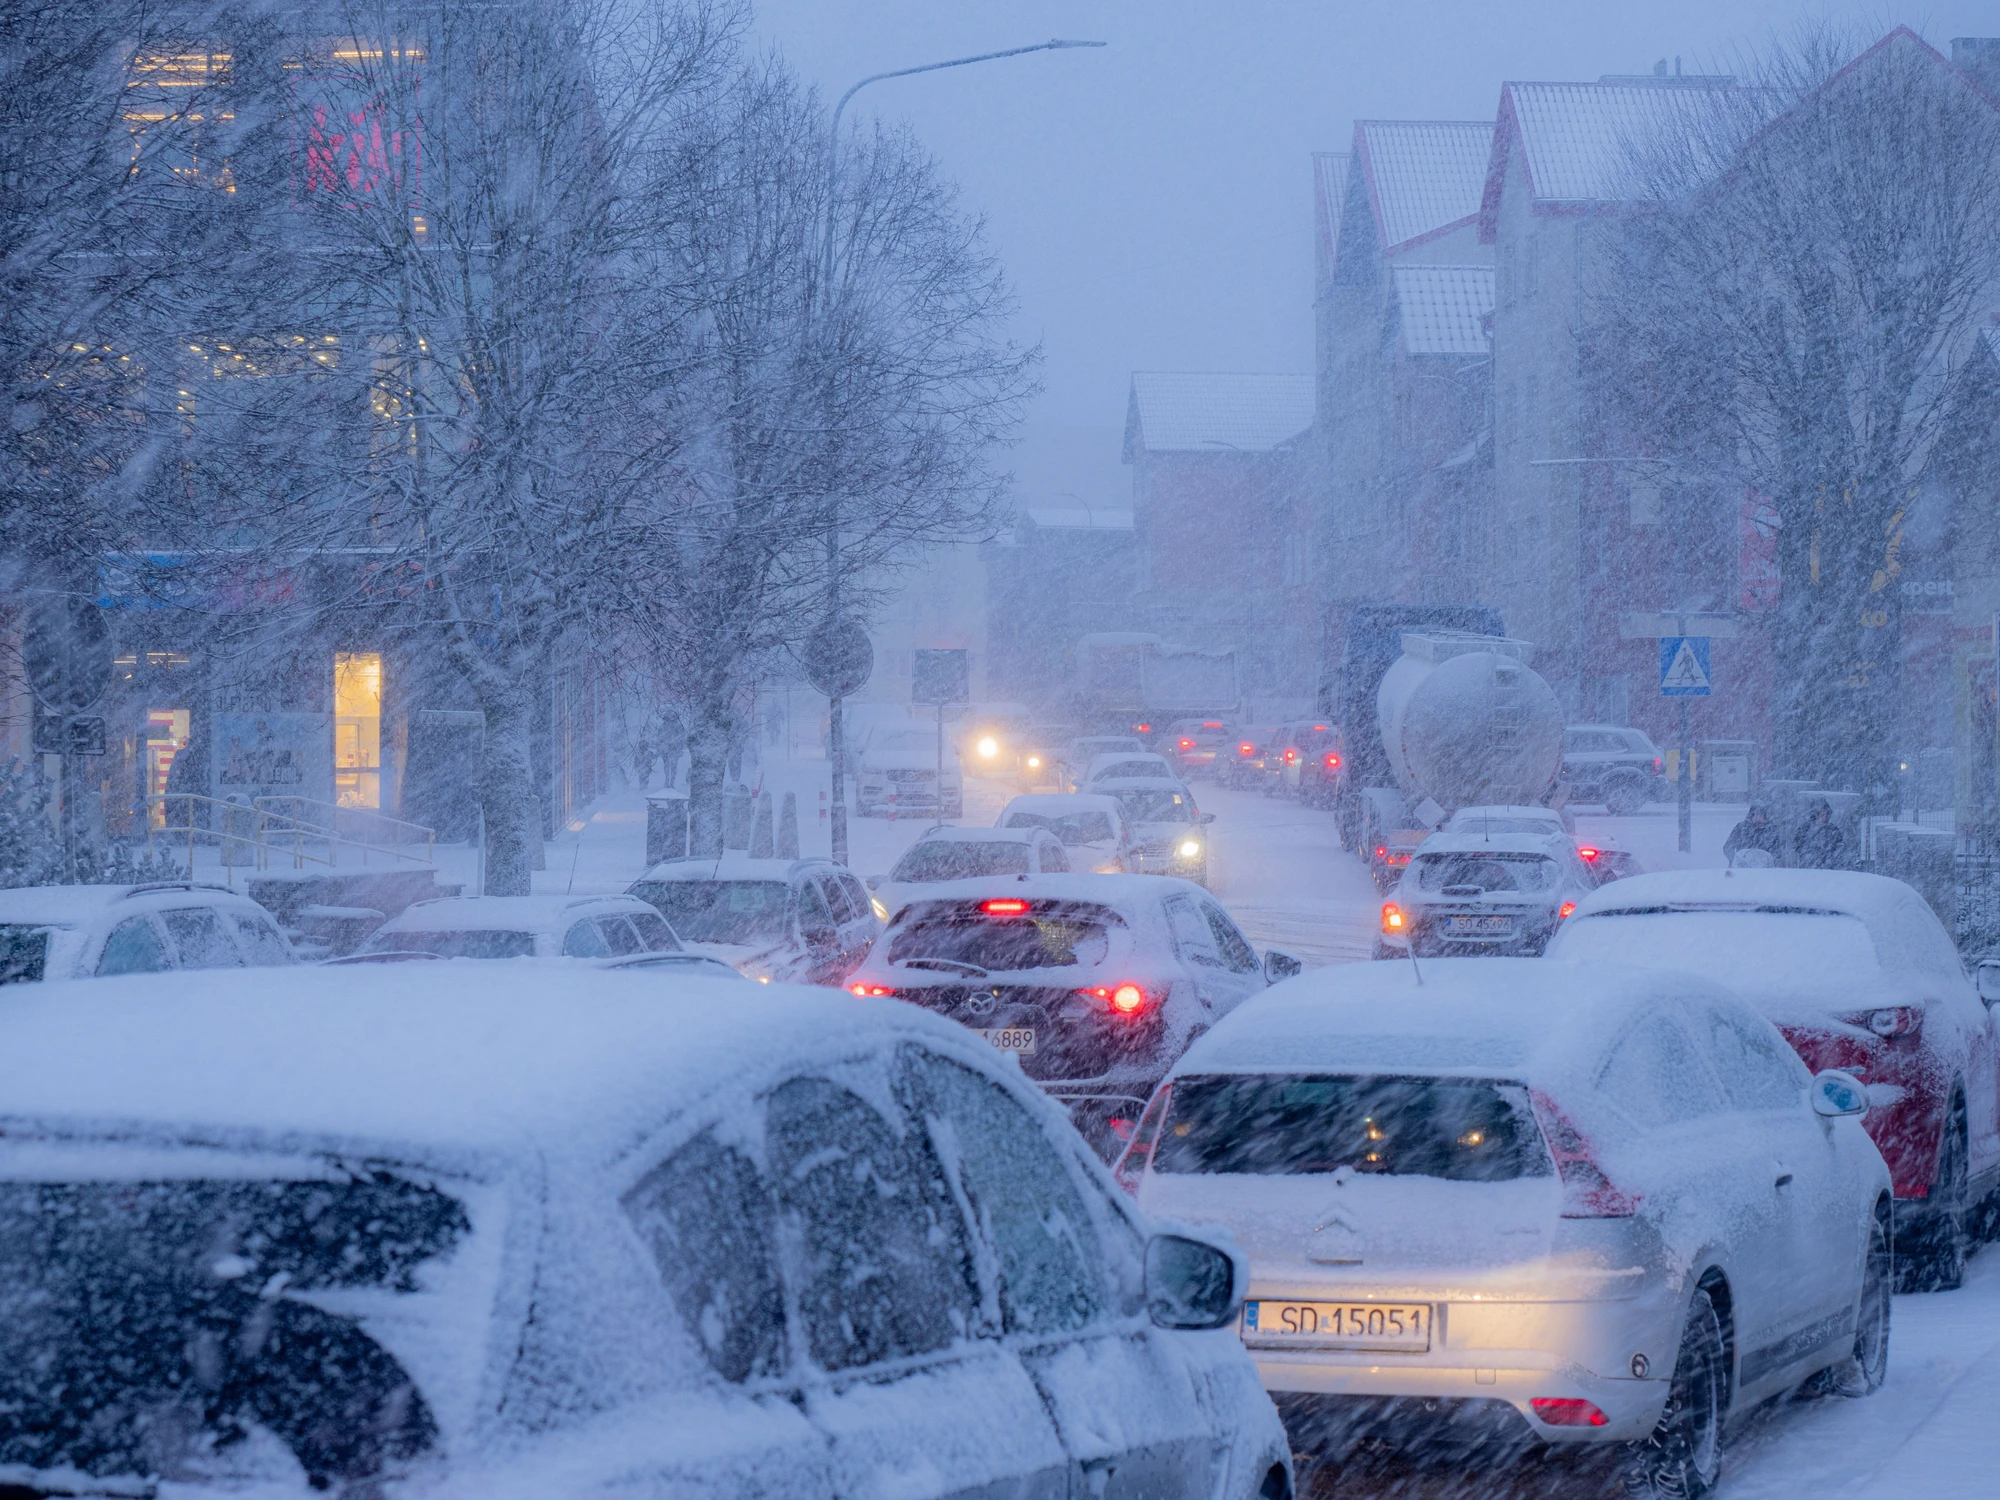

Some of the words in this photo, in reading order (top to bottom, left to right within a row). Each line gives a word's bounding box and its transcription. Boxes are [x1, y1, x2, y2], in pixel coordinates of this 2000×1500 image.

[1459, 919, 1473, 930] SD
[1281, 1306, 1318, 1334] SD
[1332, 1307, 1421, 1336] 15051
